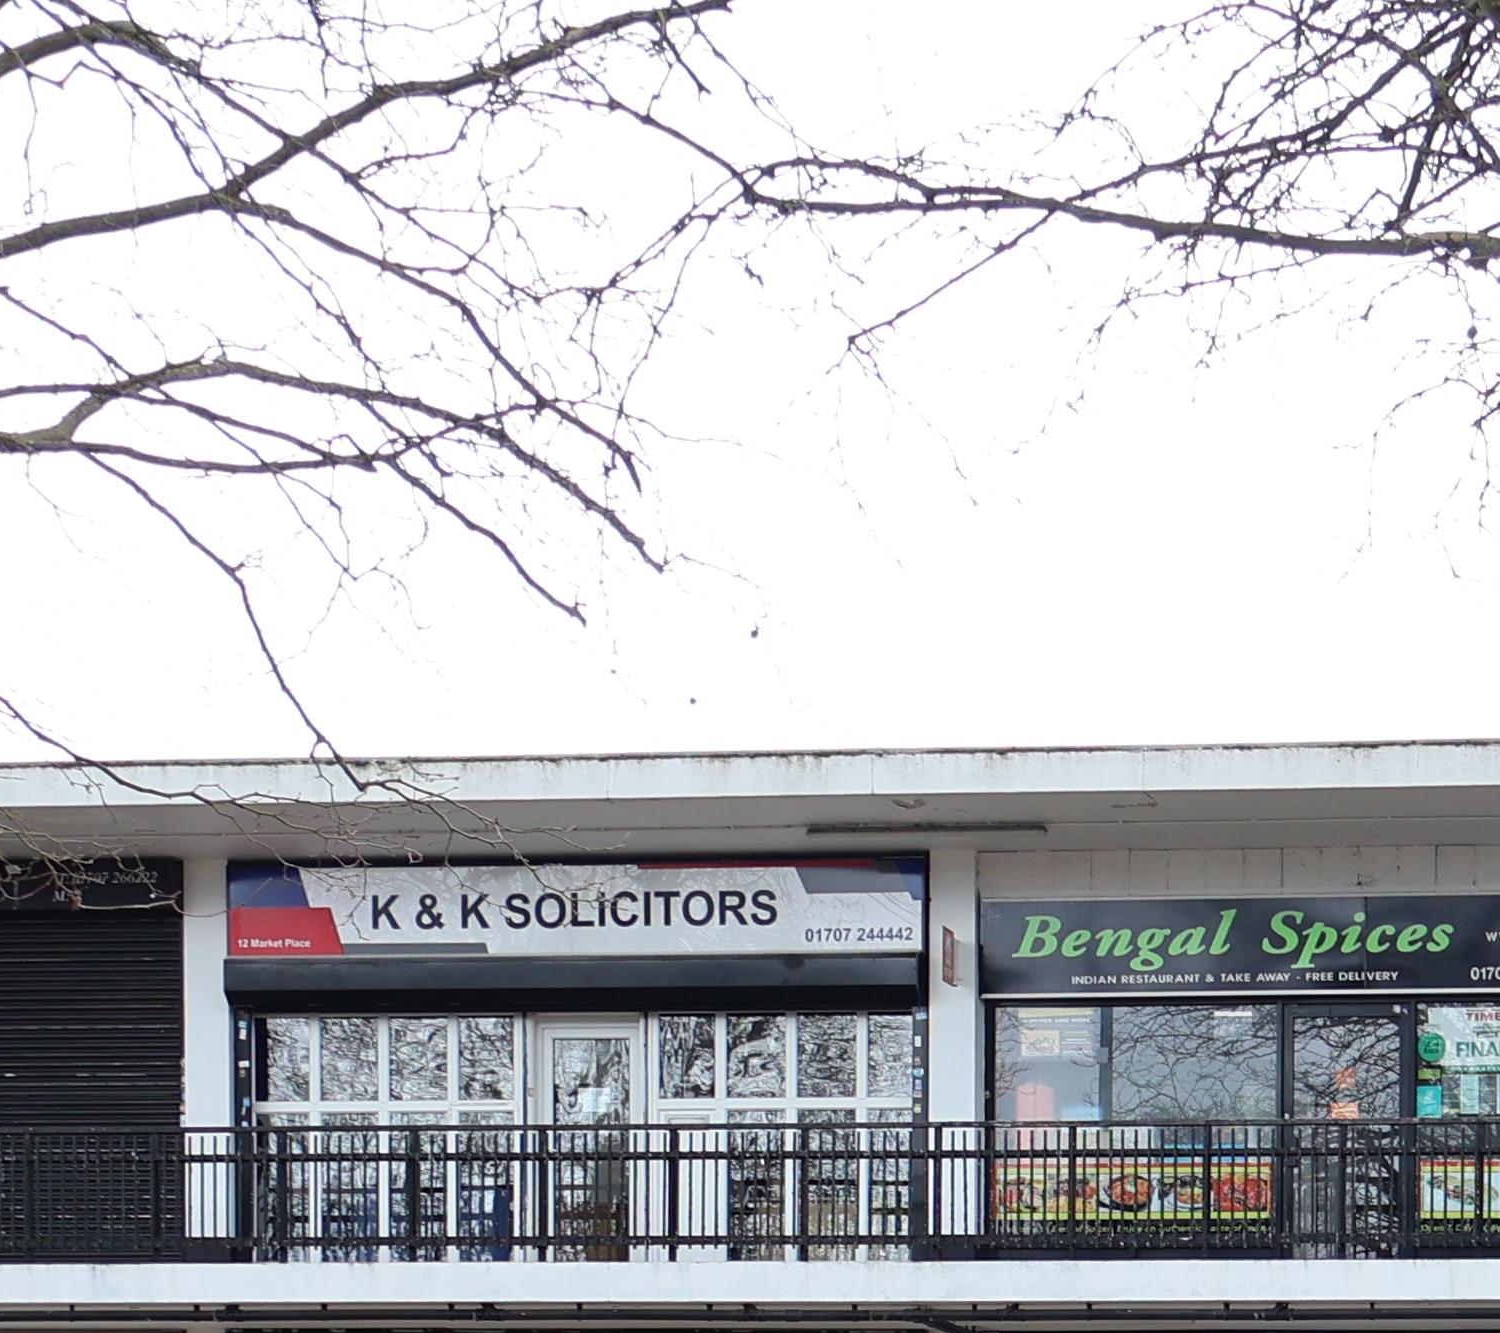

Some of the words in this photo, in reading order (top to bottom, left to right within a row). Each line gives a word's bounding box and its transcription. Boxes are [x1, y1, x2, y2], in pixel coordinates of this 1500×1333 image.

[372, 893, 401, 930] K
[415, 893, 445, 930] &
[461, 893, 490, 930] K
[504, 889, 778, 930] SOLICITORS
[805, 928, 851, 943] 01707
[857, 927, 914, 942] 244442
[1011, 908, 1236, 972] Bengal
[1262, 910, 1456, 970] Spices
[237, 939, 249, 949] 12
[250, 938, 283, 949] Market
[284, 938, 311, 949] Place
[1070, 975, 1117, 985] INDIAN
[1120, 974, 1200, 985] RESTAURANT
[1205, 974, 1215, 983] &
[1220, 973, 1252, 983] TAKE
[1255, 972, 1291, 983] AWAY
[1305, 971, 1335, 982] FREE
[1338, 970, 1399, 982] DELIVERY
